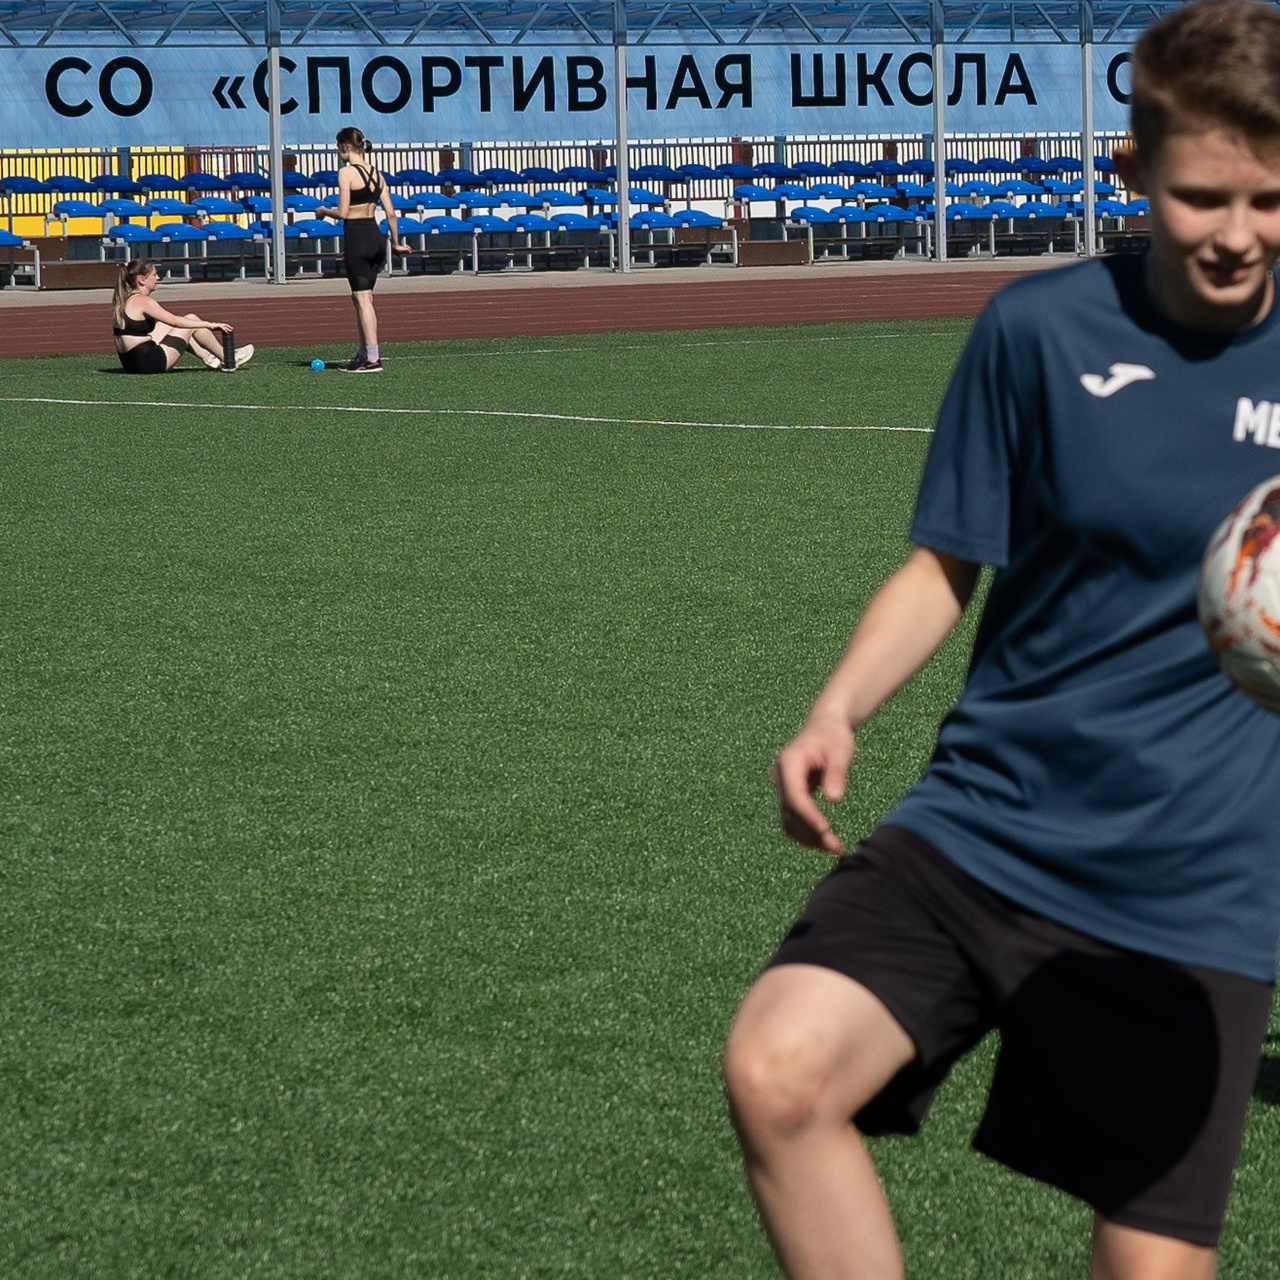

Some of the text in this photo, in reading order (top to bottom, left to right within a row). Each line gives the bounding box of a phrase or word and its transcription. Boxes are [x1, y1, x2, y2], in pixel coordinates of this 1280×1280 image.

[45, 55, 153, 118] СО
[211, 52, 753, 116] «СПОРТИВНАЯ
[790, 51, 1038, 108] ШКОЛА
